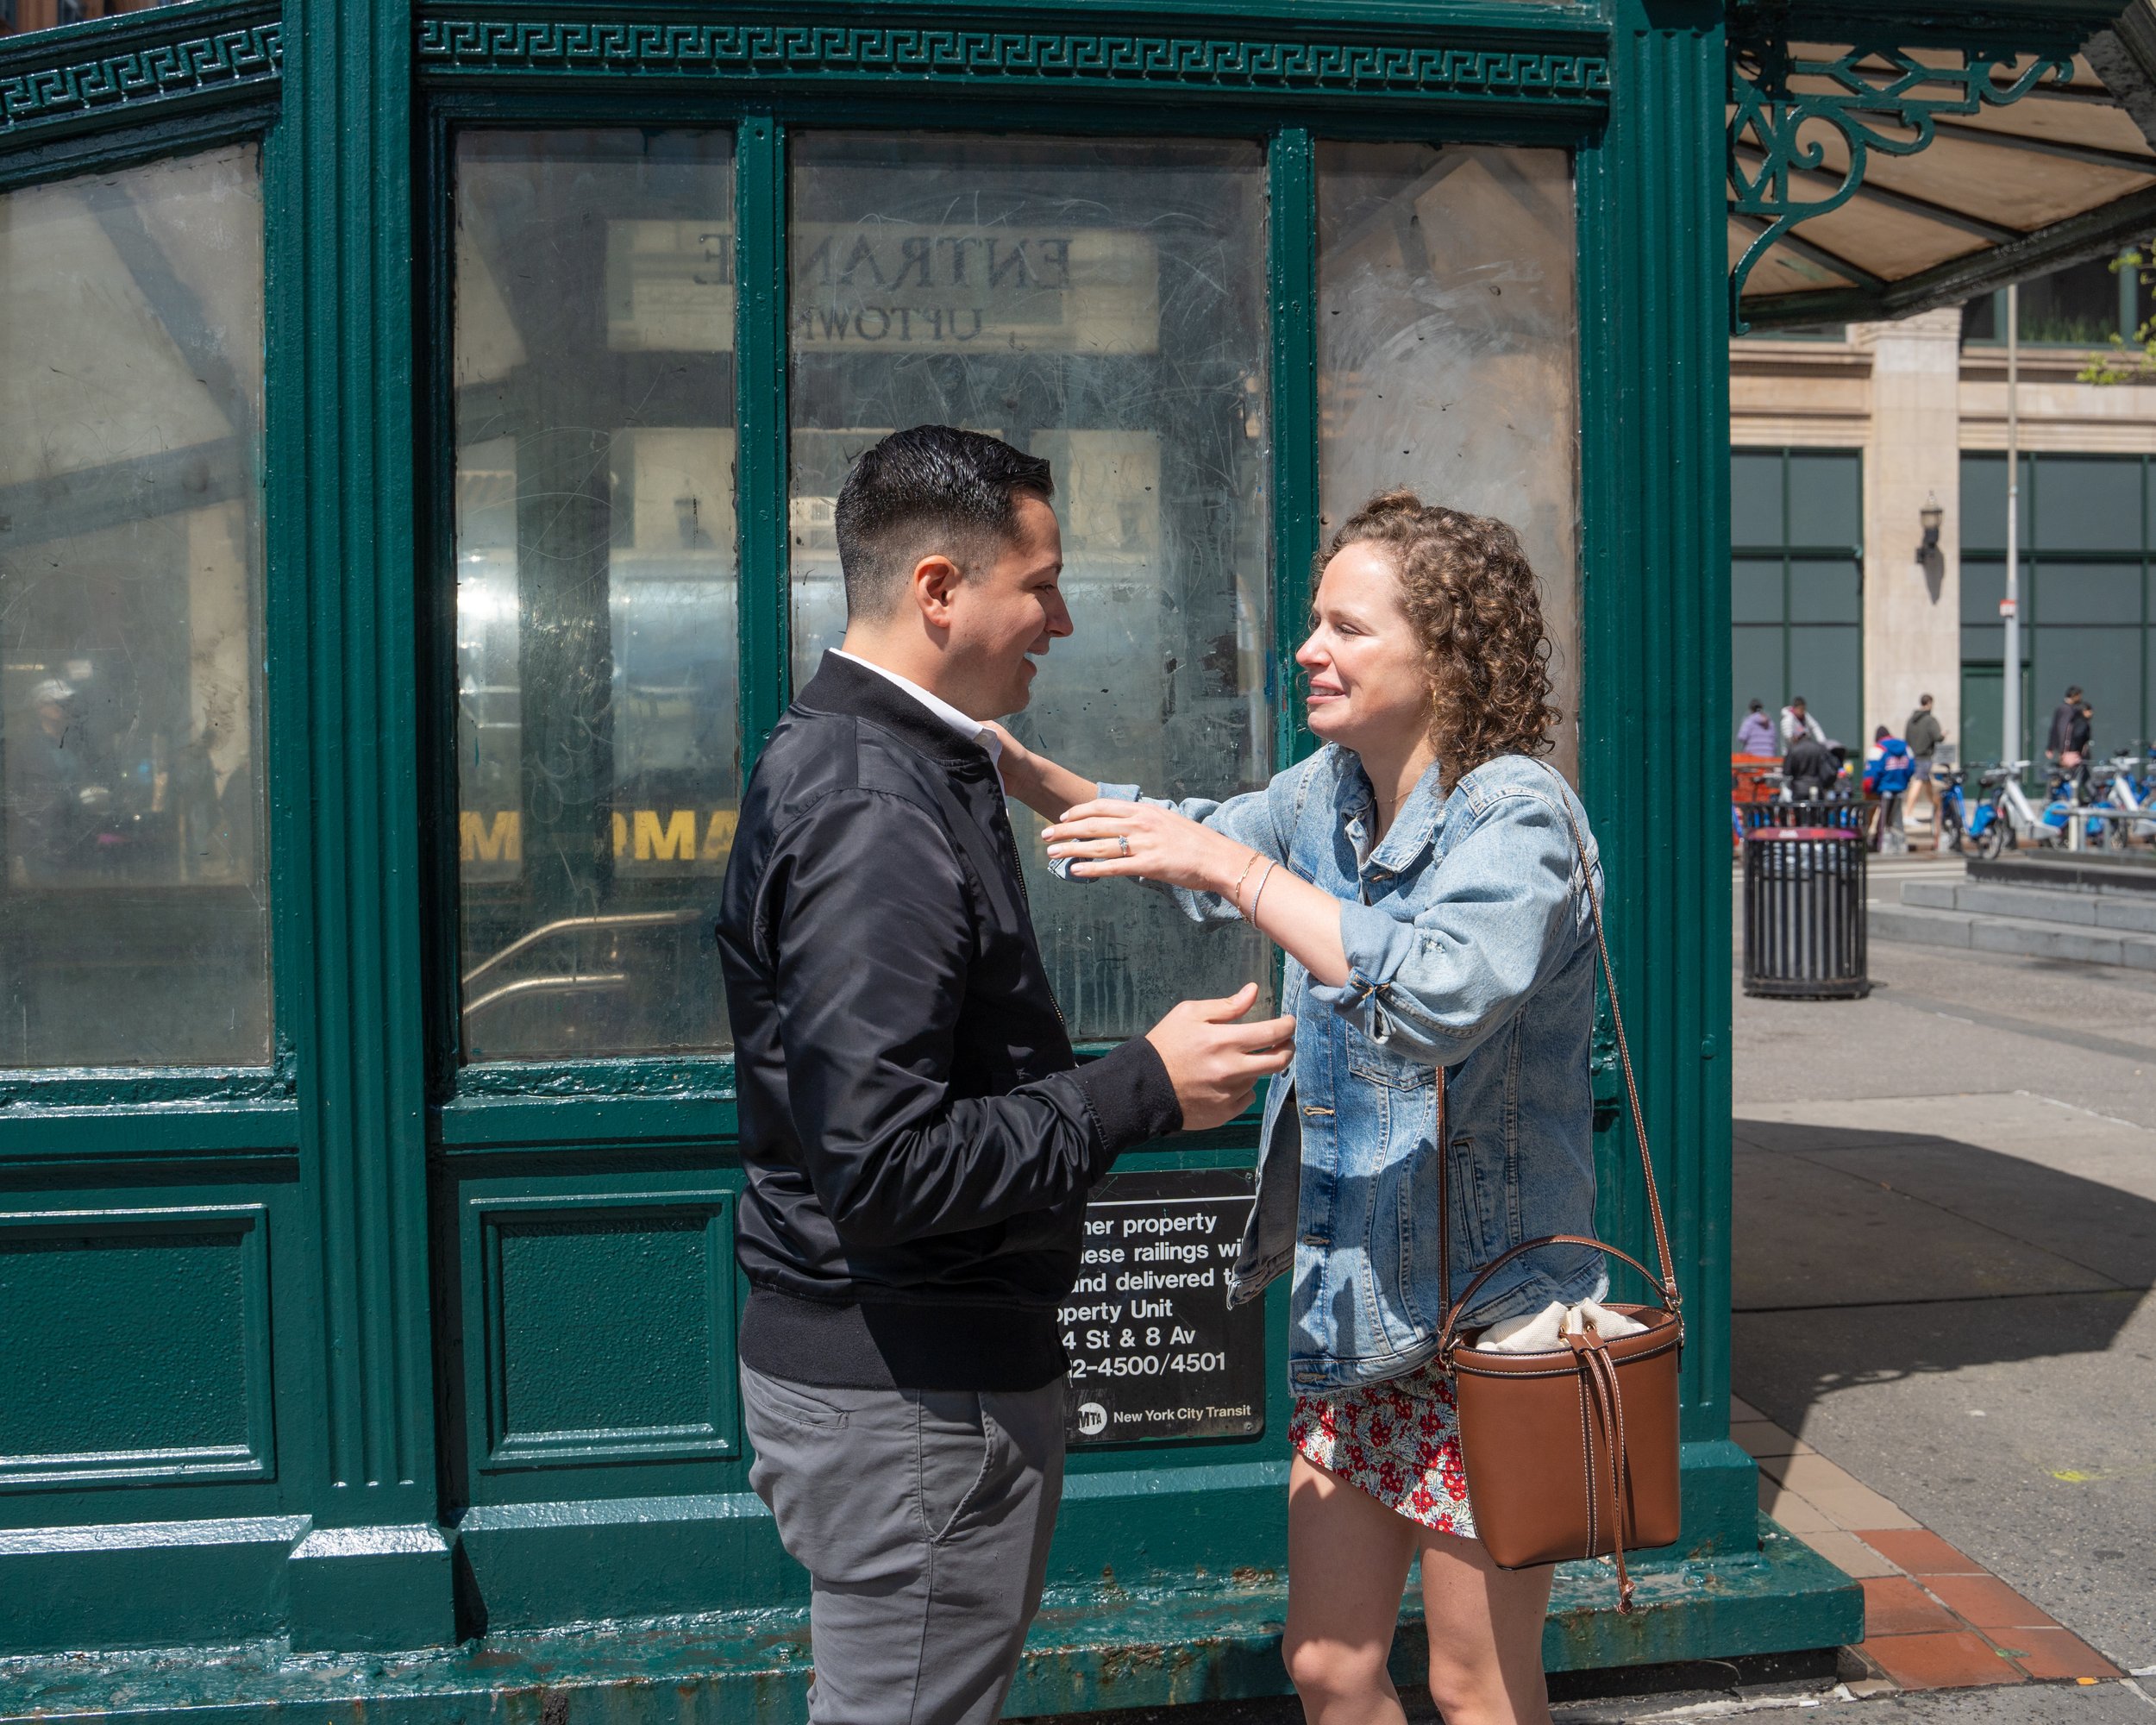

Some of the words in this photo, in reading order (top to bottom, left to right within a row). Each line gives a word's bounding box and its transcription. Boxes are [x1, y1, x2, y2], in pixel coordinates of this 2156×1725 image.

[1123, 1212, 1218, 1238] property
[1081, 1247, 1125, 1264] ese
[1134, 1239, 1209, 1264] railings
[1218, 1237, 1244, 1258] wi
[1115, 1267, 1214, 1292] delivered
[1131, 1298, 1174, 1319] Unit
[1086, 1329, 1111, 1350] St
[1119, 1328, 1137, 1348] &
[1145, 1327, 1161, 1346] 8
[1169, 1326, 1197, 1346] Av
[1069, 1352, 1226, 1379] 2-4500/4501
[1113, 1411, 1143, 1423] New
[1145, 1408, 1175, 1422] York
[1176, 1407, 1205, 1421] City
[1206, 1404, 1251, 1419] Transit
